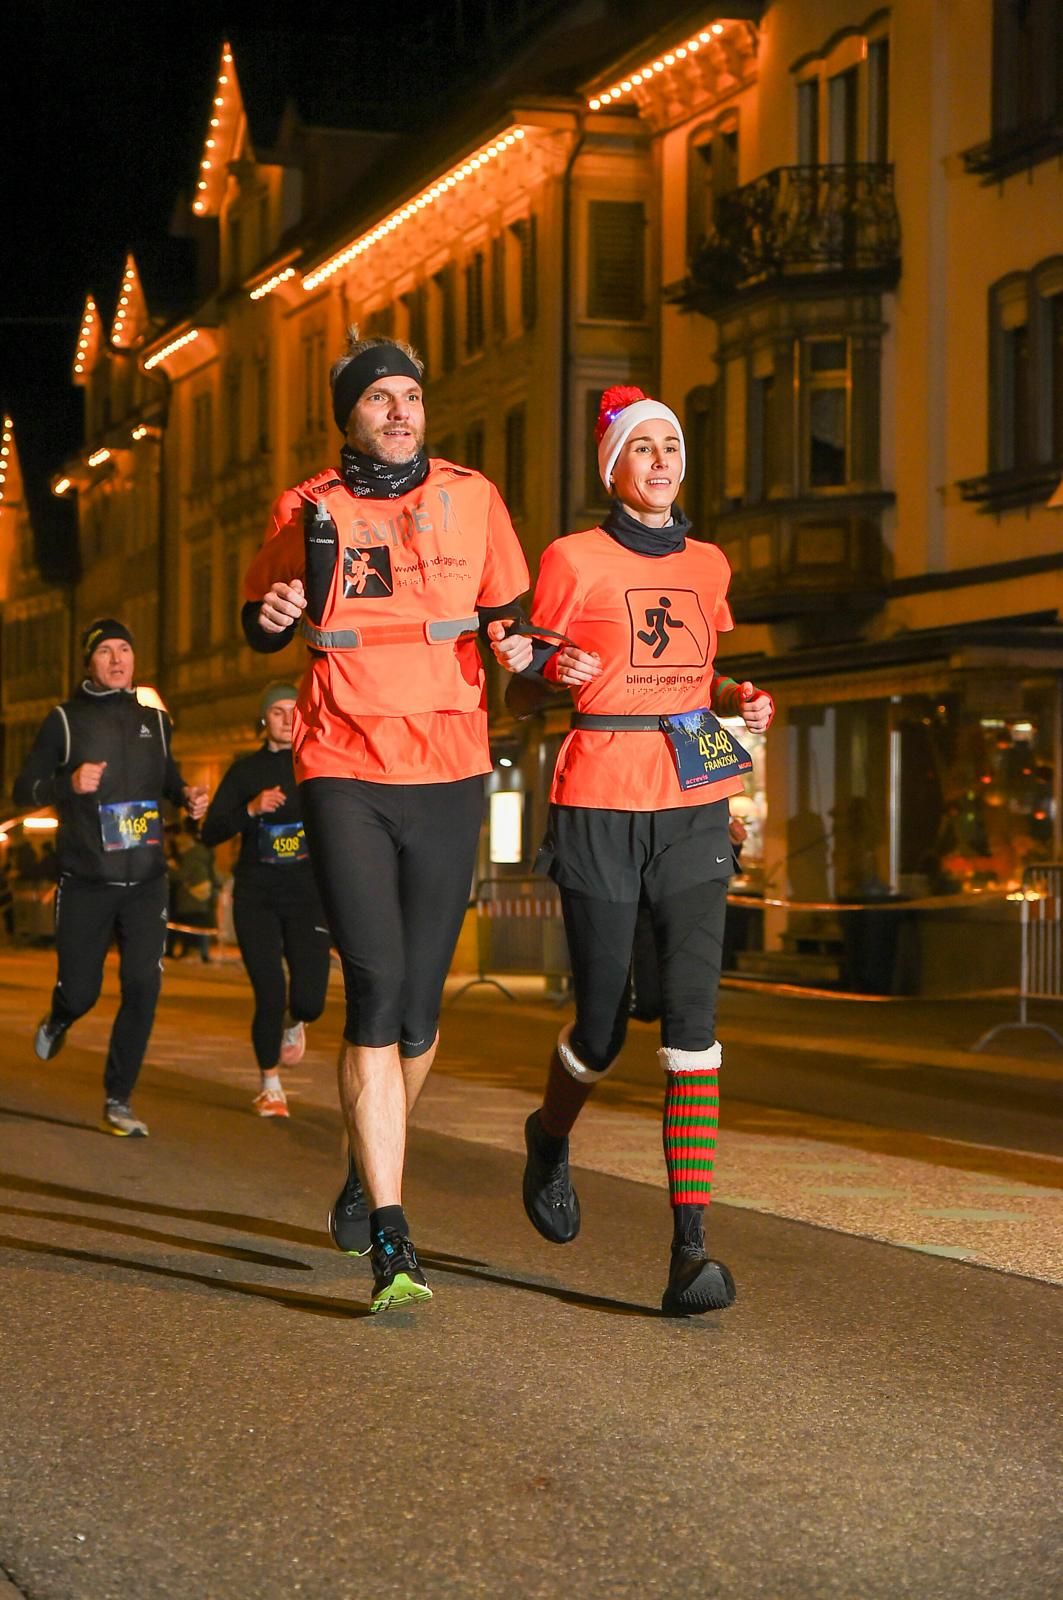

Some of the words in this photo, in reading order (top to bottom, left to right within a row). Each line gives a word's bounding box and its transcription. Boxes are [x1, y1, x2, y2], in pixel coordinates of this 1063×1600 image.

[352, 502, 432, 546] GUIDE
[699, 730, 733, 759] 4548
[704, 754, 739, 772] FRANZISKA
[685, 774, 709, 785] acrevis
[118, 817, 148, 834] 4168
[272, 836, 299, 852] 4508
